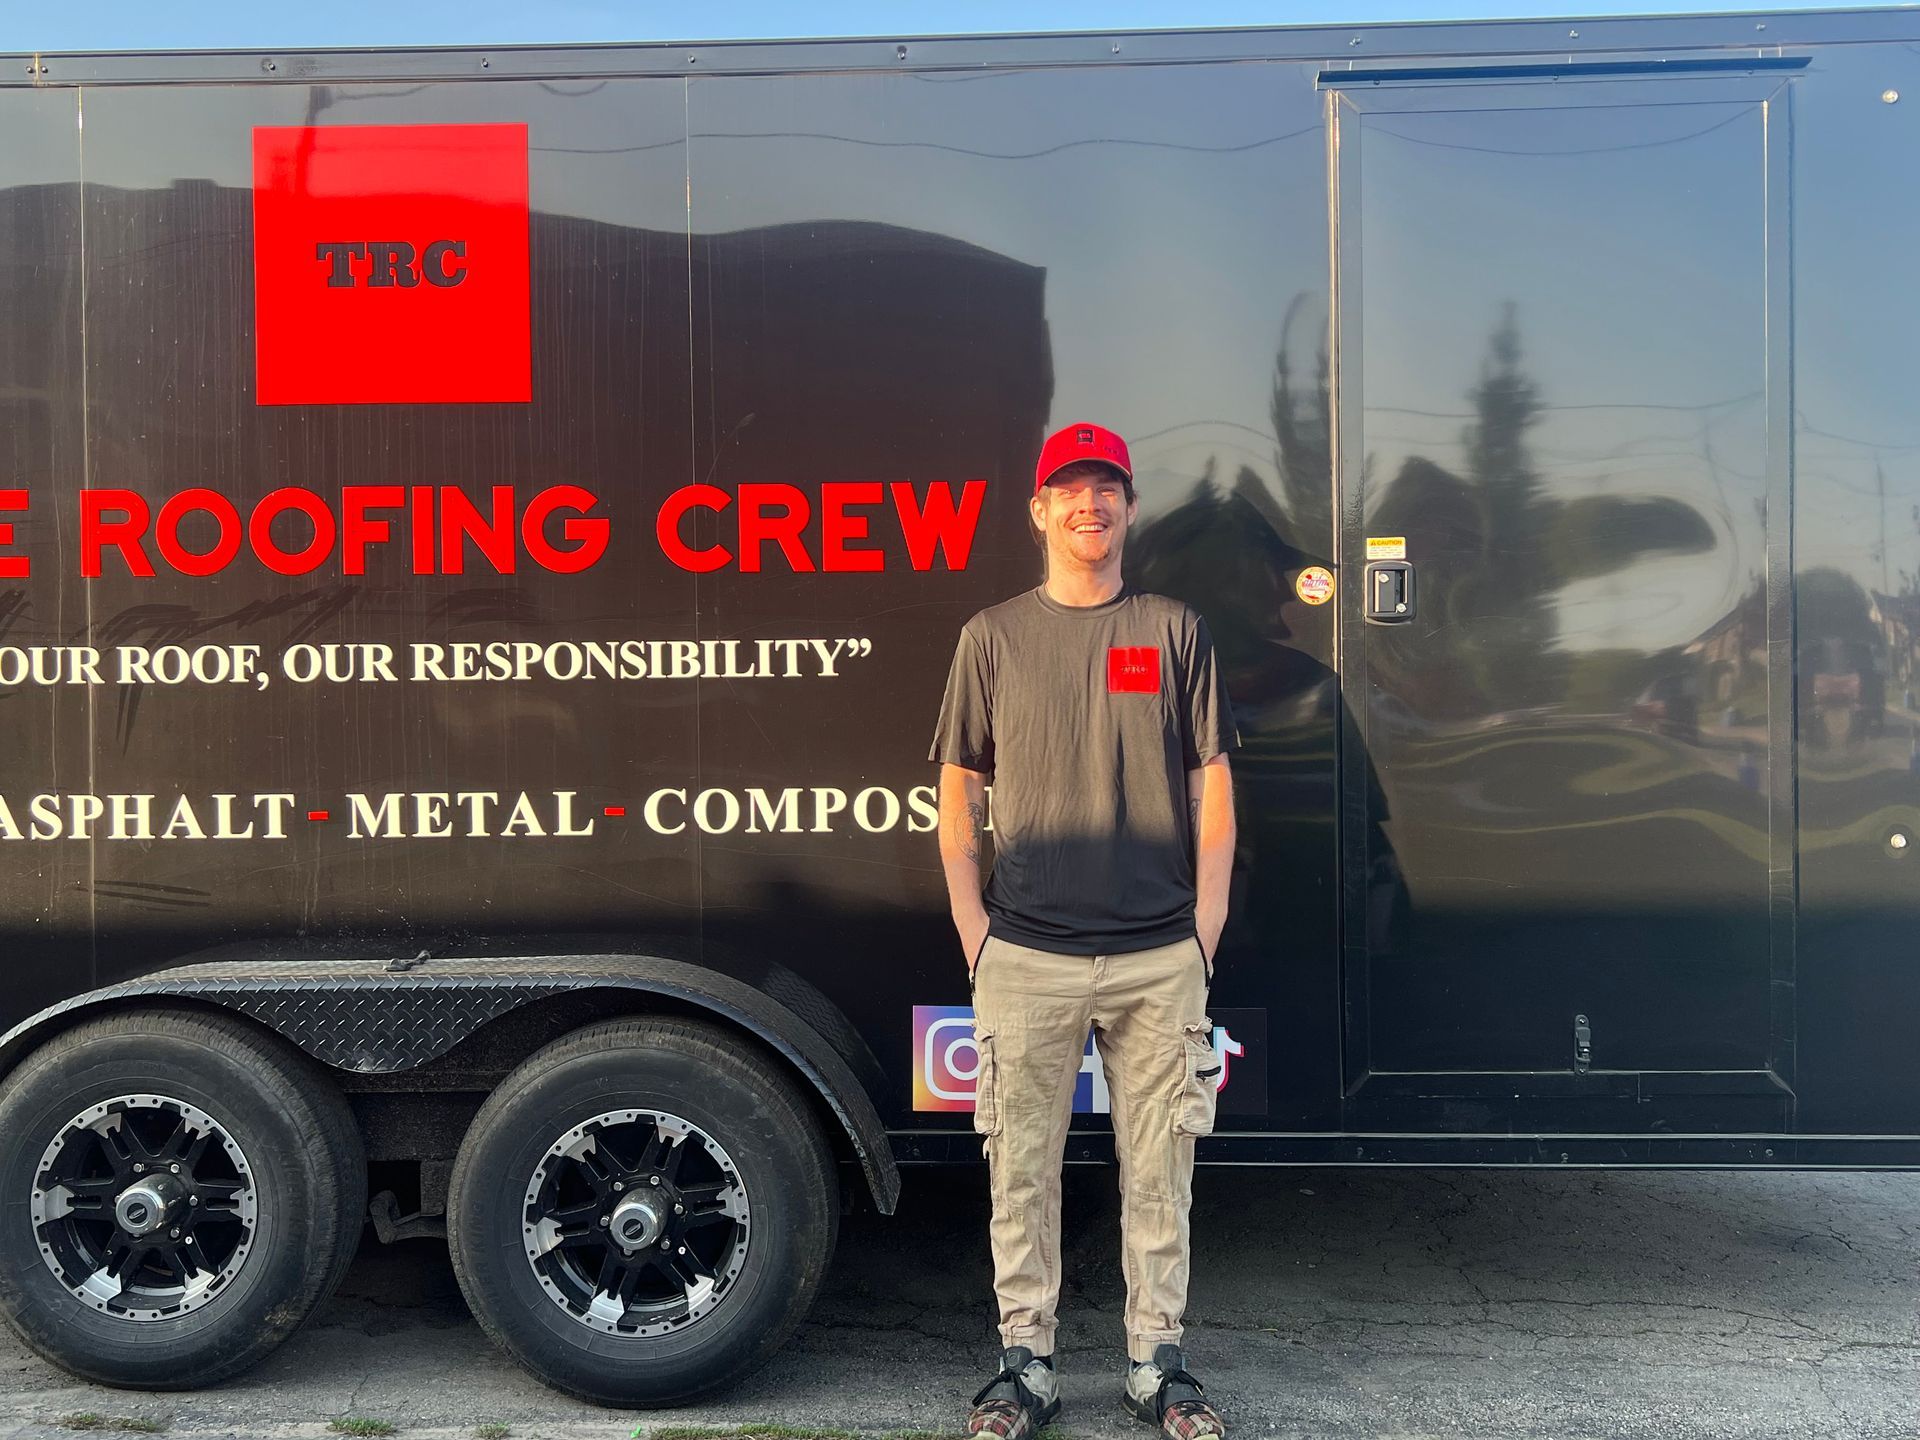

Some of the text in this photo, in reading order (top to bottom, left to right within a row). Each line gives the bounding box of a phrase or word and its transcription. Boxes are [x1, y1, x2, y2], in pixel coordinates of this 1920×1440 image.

[316, 240, 467, 288] TRC
[80, 485, 610, 578] ROOFING
[656, 480, 987, 573] CREW
[116, 645, 269, 691] ROOF,
[283, 643, 398, 682] OUR
[0, 793, 295, 840] ASPHALT
[345, 791, 594, 839] METAL
[643, 786, 993, 834] COMPOS
